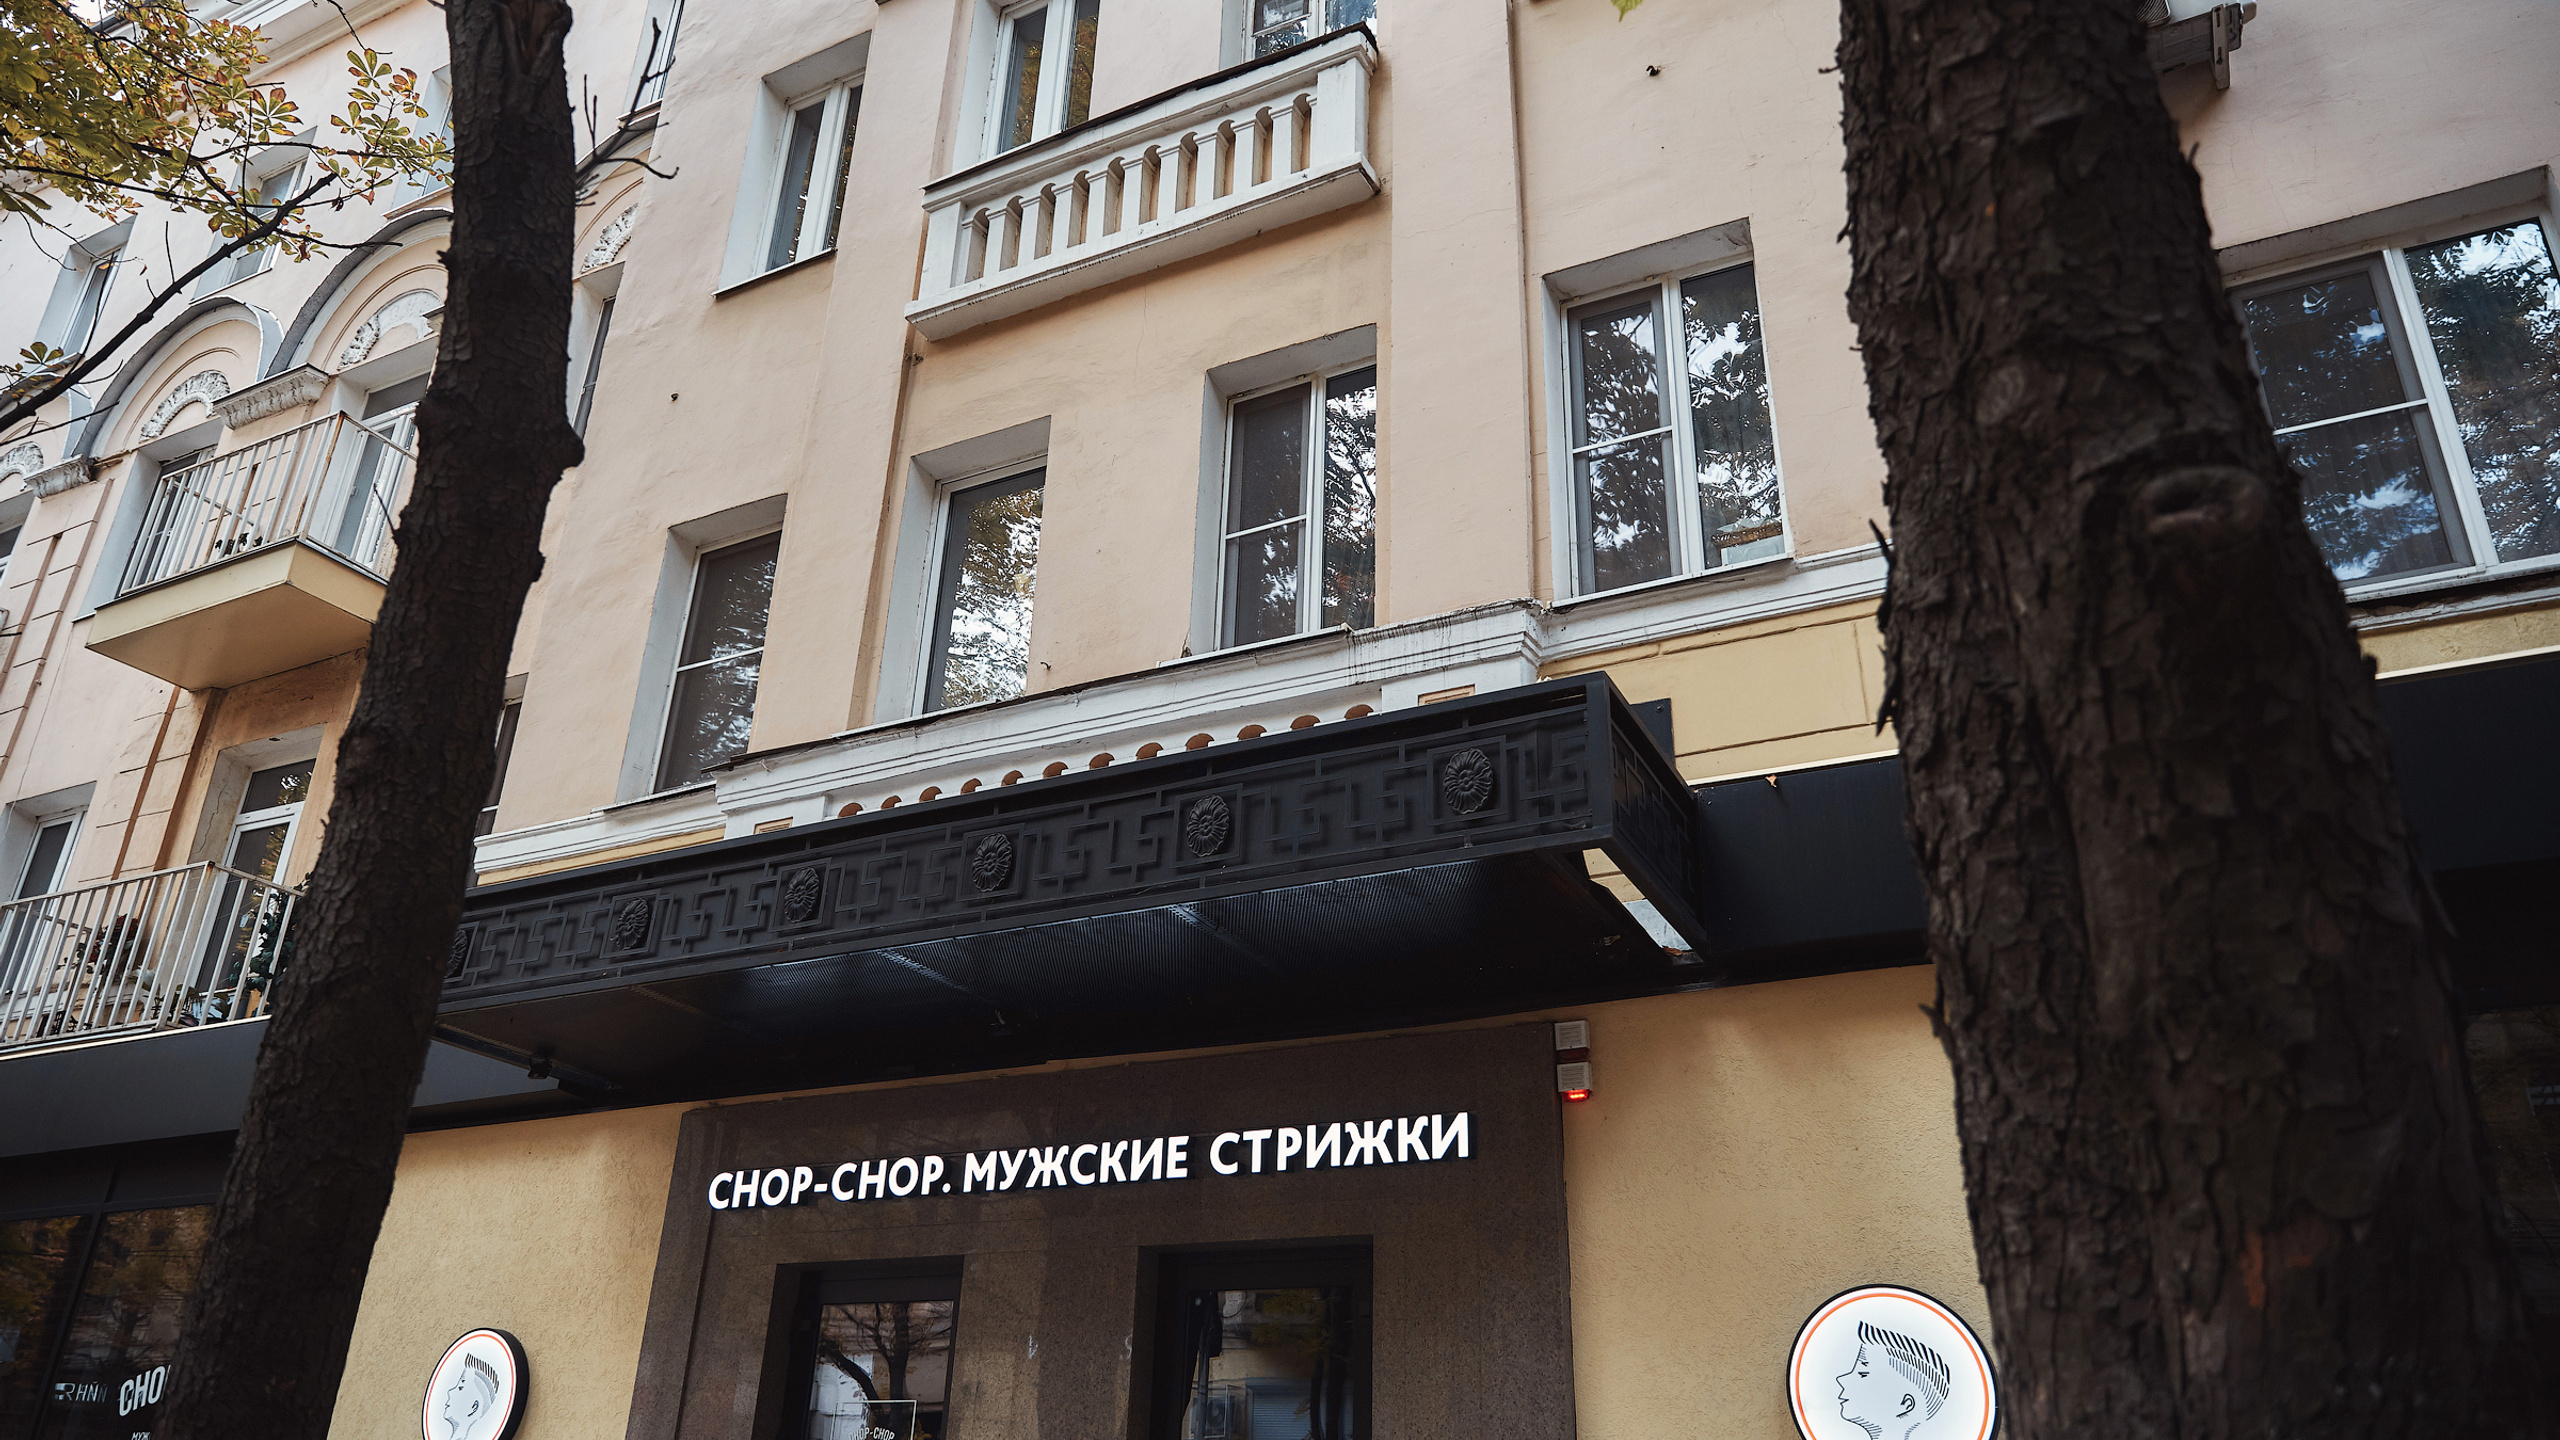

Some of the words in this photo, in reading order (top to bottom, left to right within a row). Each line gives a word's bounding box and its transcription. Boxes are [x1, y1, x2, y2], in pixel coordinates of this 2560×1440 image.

[708, 1155, 951, 1210] CHOP-CHOP.
[962, 1135, 1190, 1193] МУЖСКИЕ
[1209, 1112, 1469, 1175] СТРИЖКИ
[118, 1364, 171, 1417] CHO
